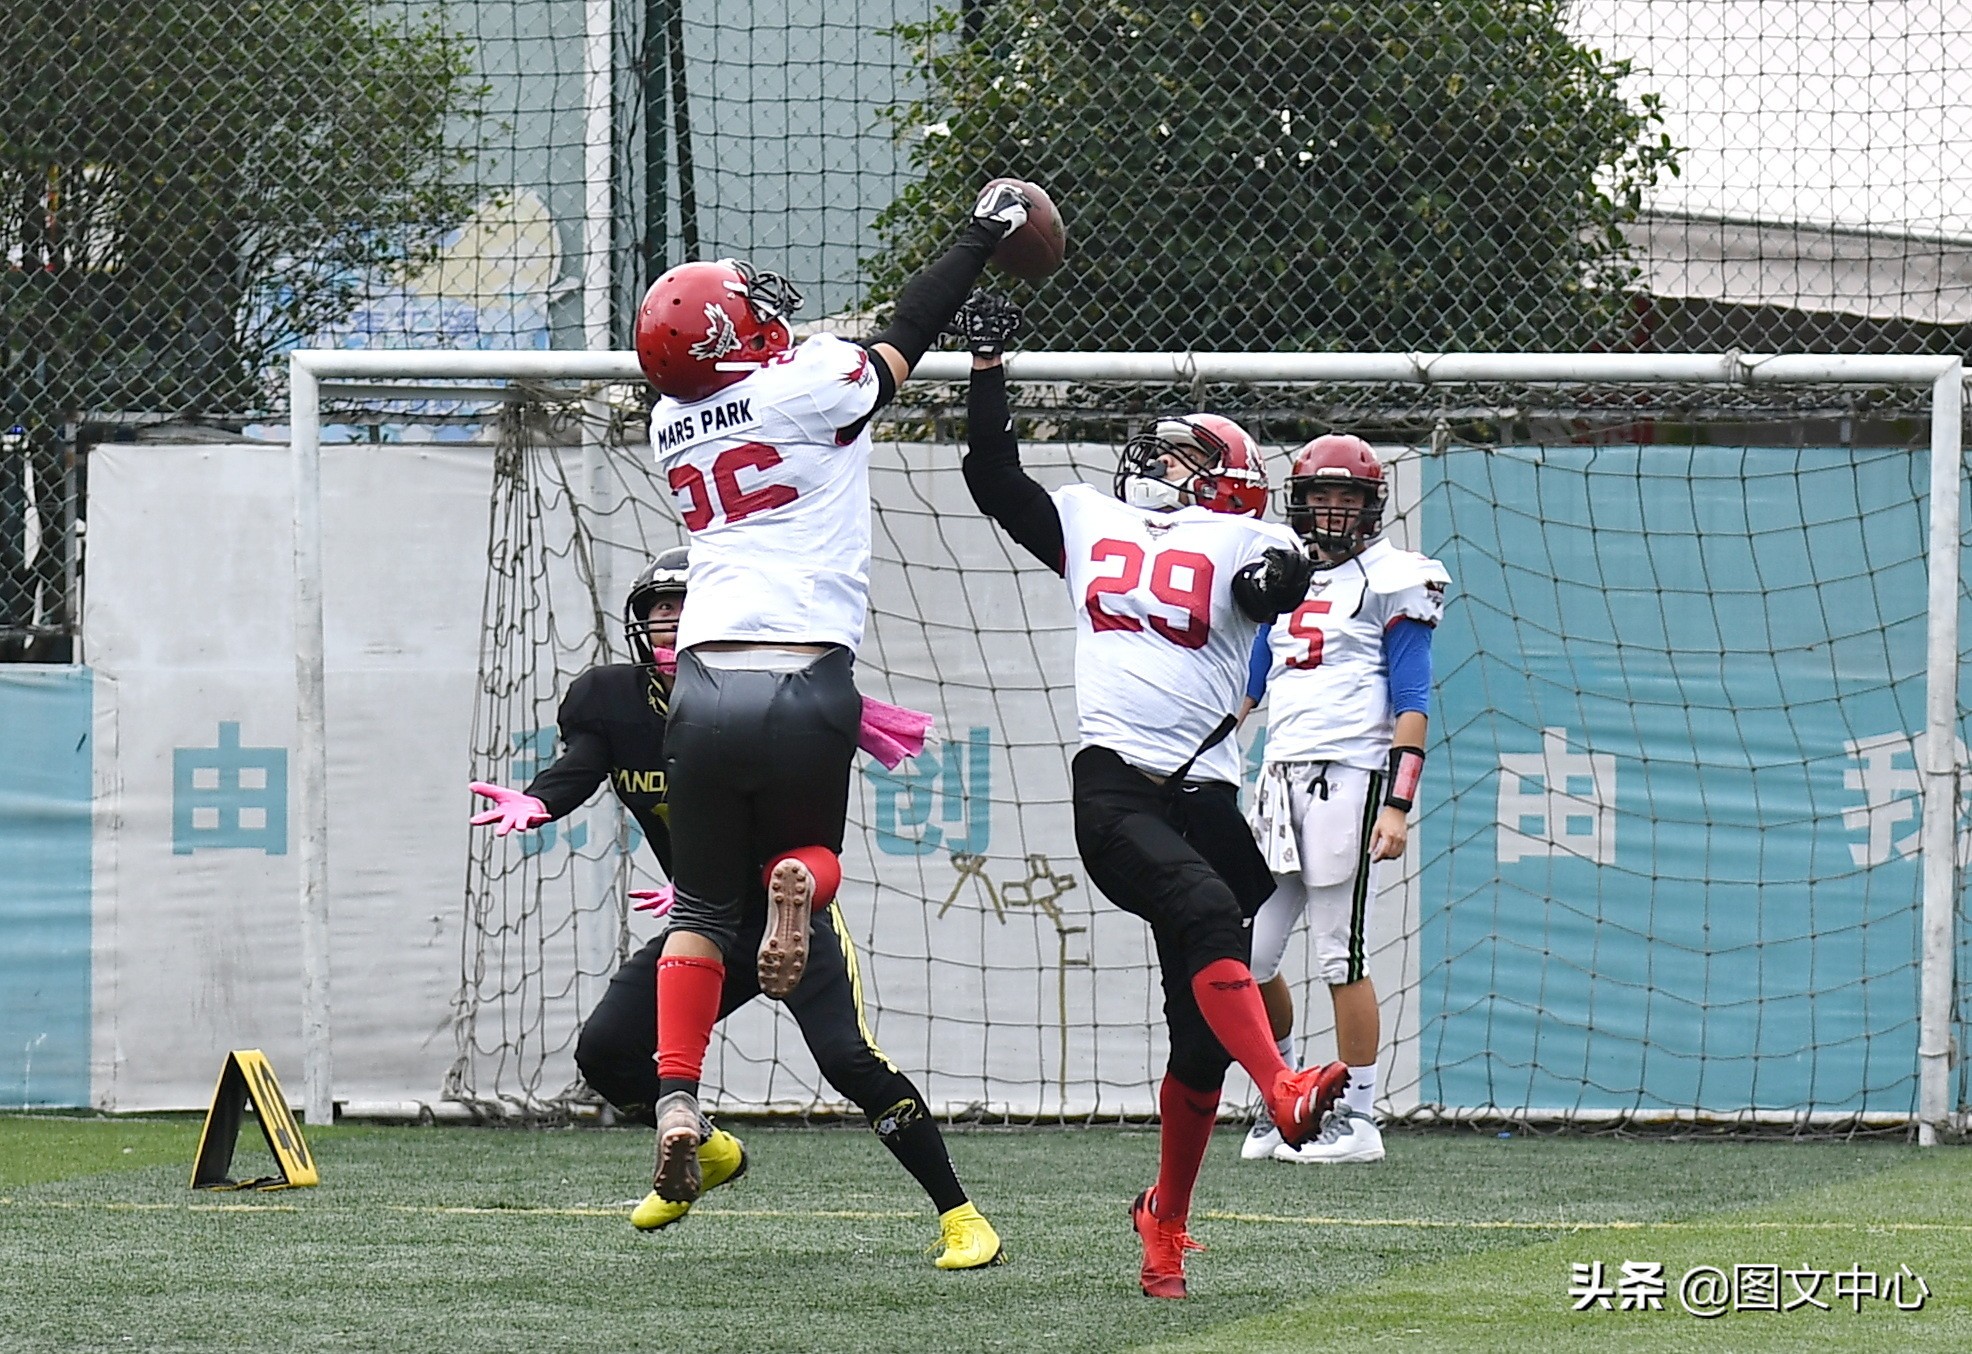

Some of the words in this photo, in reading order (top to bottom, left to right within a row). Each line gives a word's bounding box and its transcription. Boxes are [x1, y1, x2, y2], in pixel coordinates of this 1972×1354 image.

[658, 417, 694, 453] MARS
[701, 398, 753, 434] PARK
[1086, 538, 1214, 650] 29
[1285, 599, 1332, 670] 5
